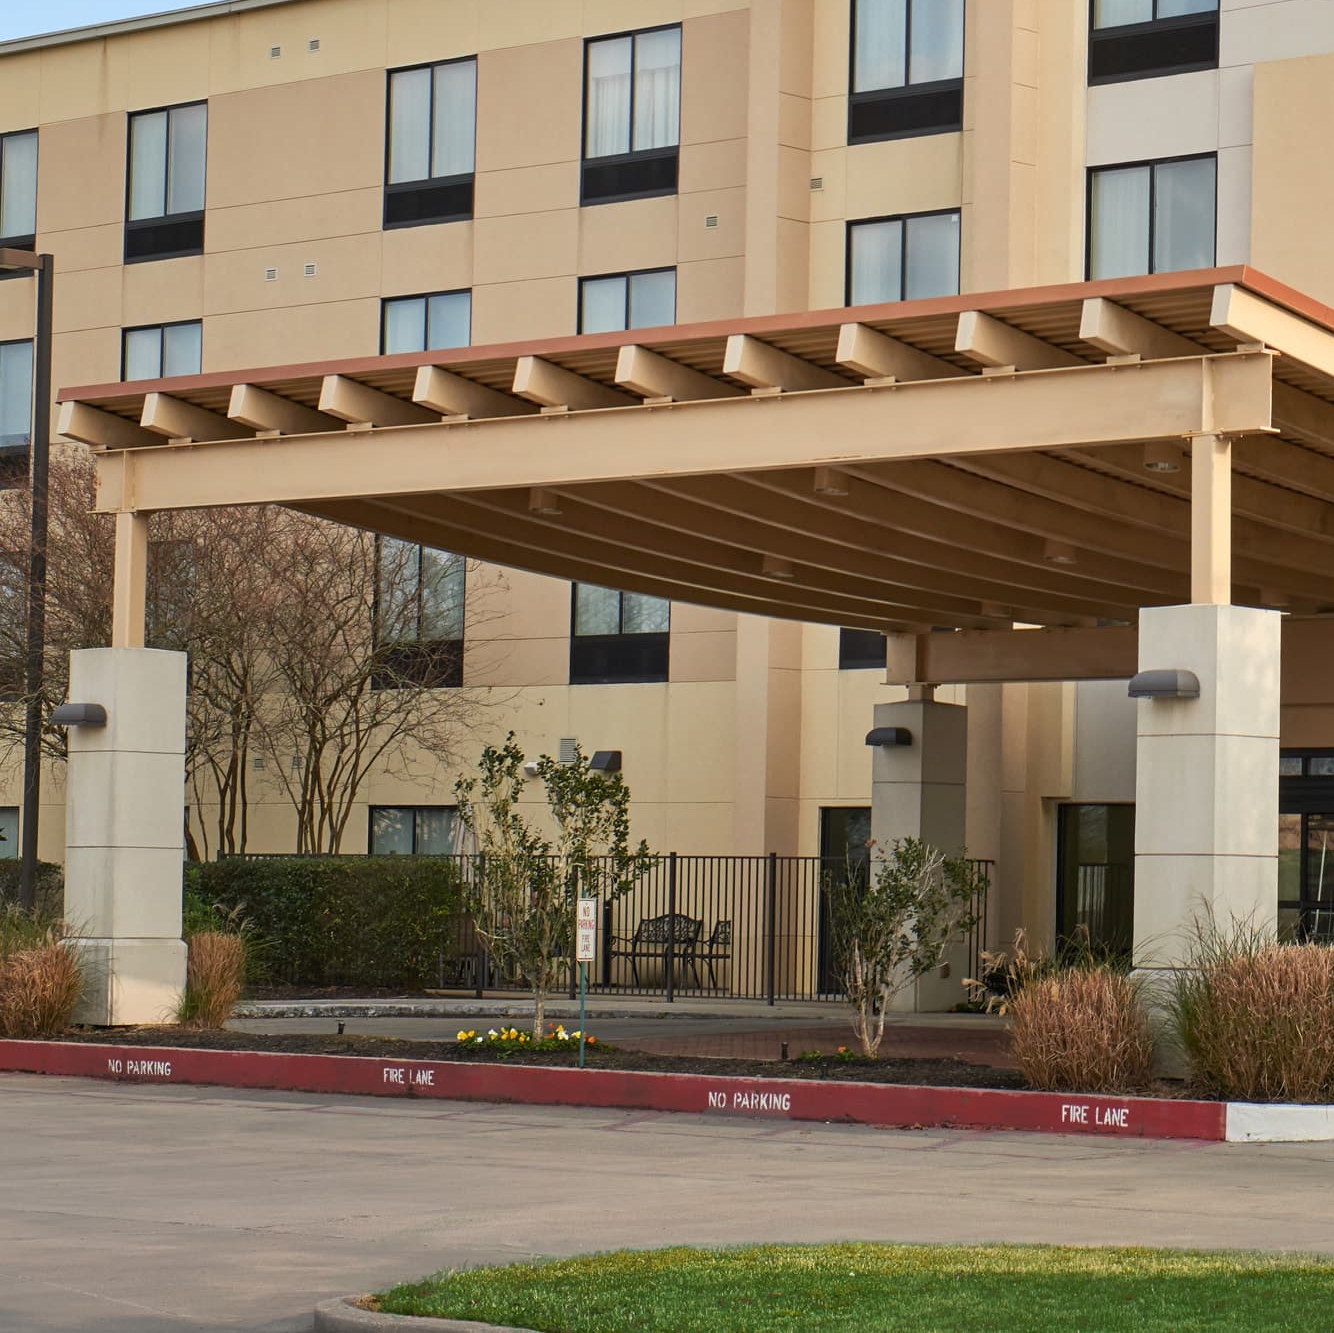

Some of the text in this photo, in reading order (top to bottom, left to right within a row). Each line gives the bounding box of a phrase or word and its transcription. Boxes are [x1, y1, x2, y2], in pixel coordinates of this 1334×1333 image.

[108, 1059, 171, 1076] NO PARKING
[383, 1068, 435, 1086] FIRE LANE
[708, 1091, 791, 1111] NO PARKING
[1061, 1104, 1130, 1128] FIRE LANE
